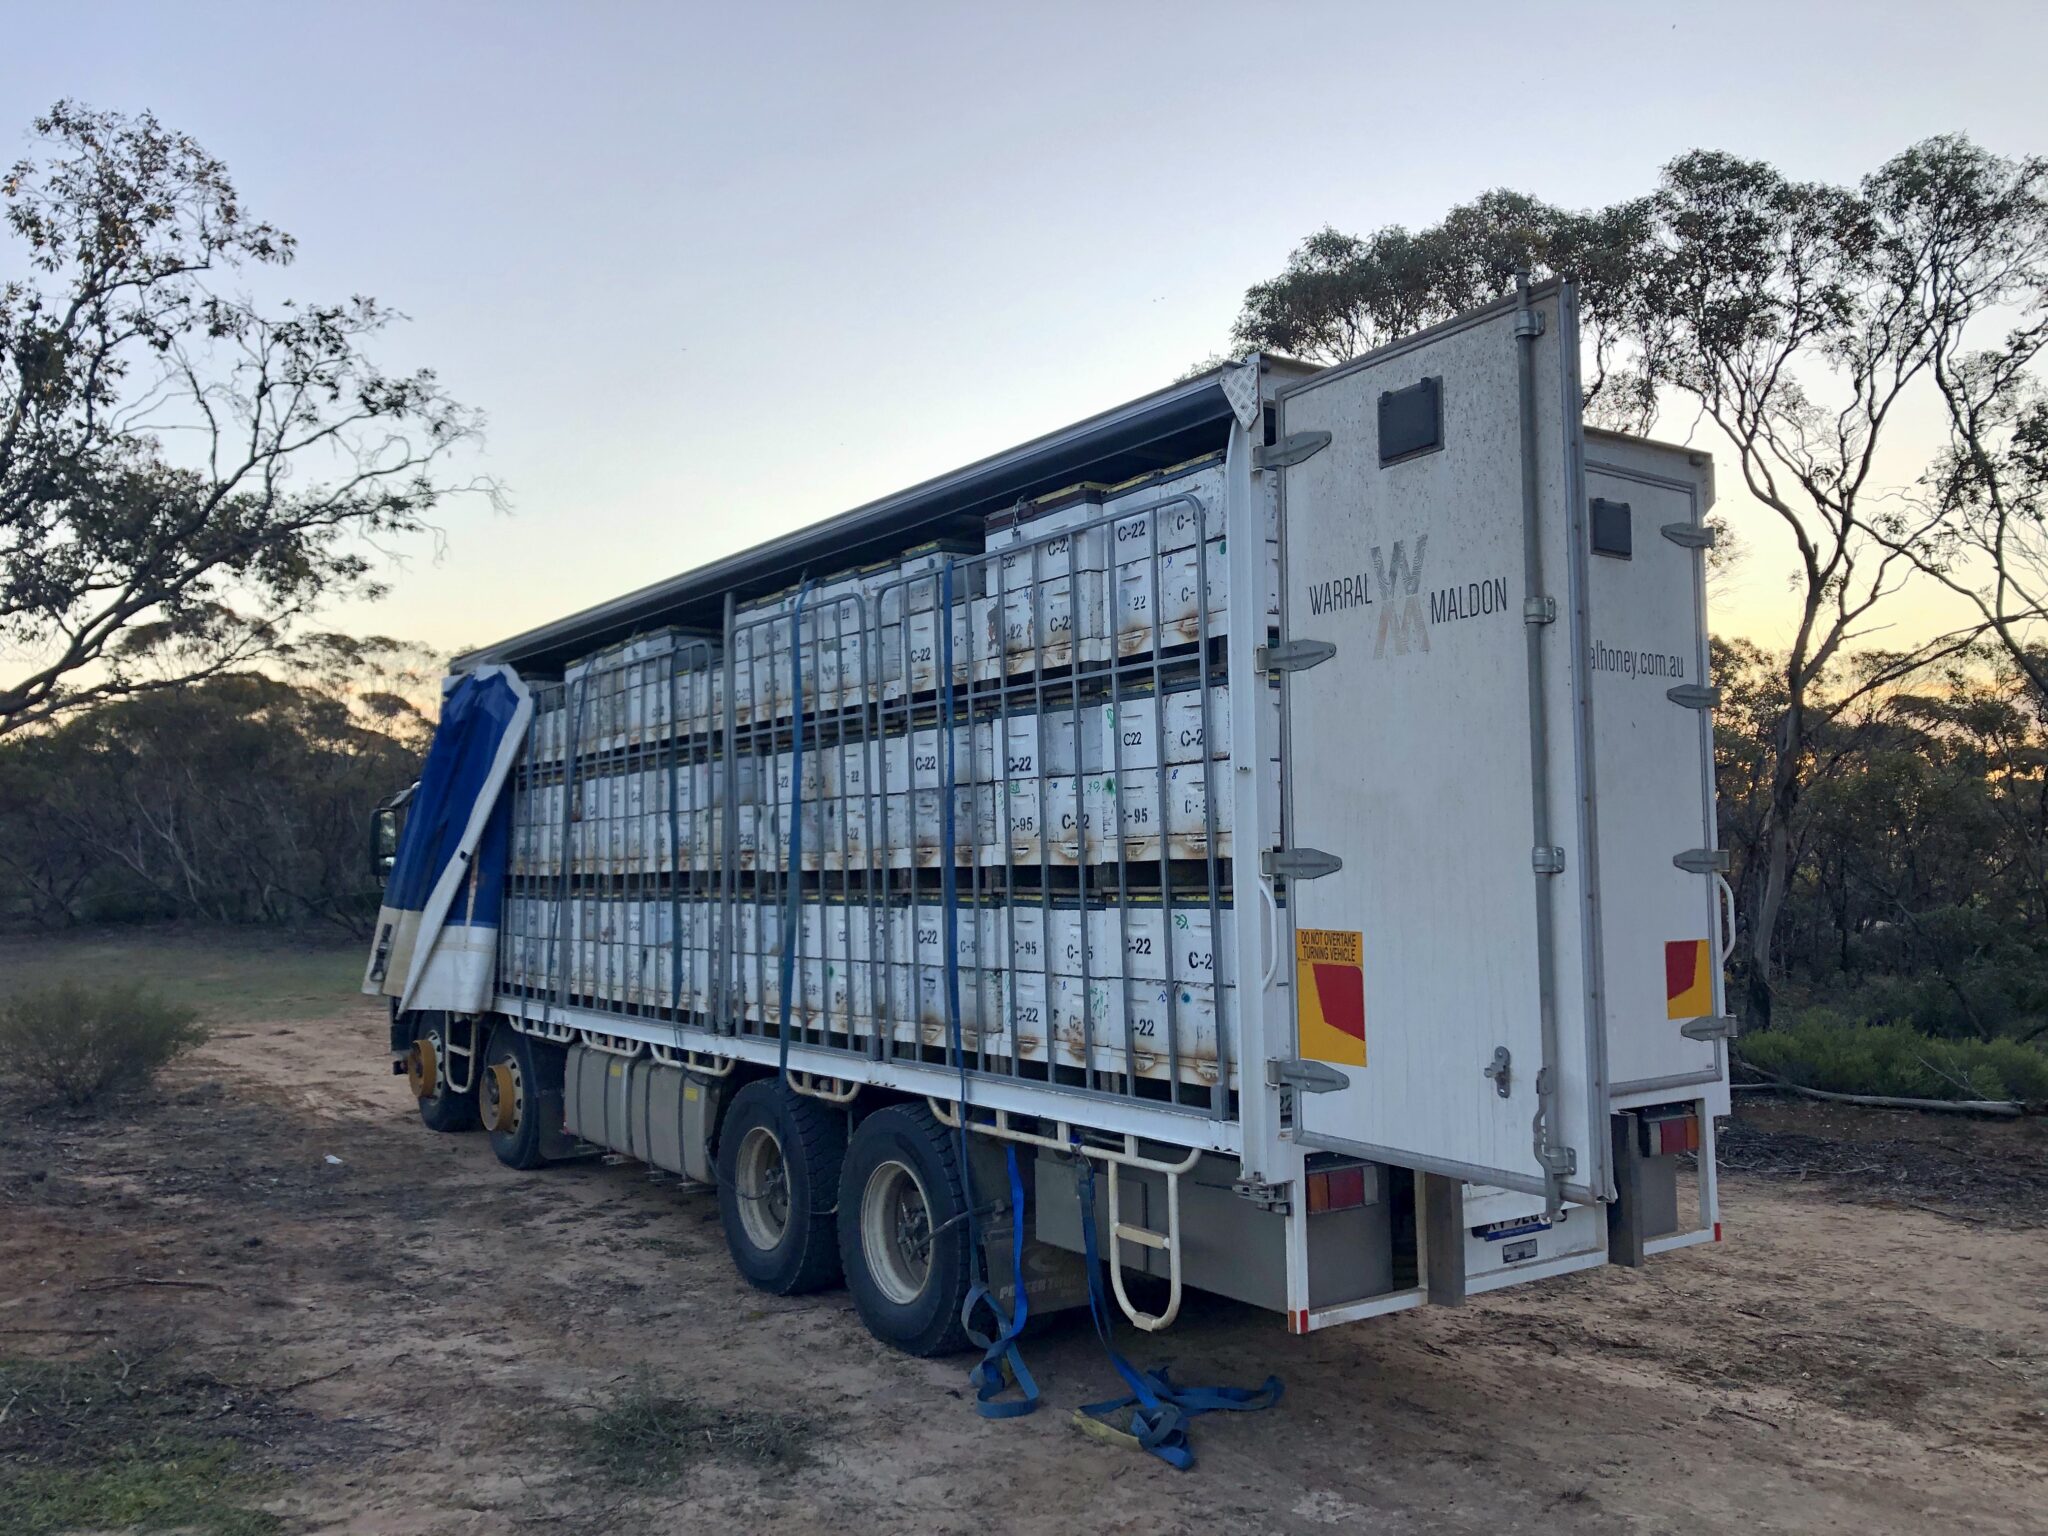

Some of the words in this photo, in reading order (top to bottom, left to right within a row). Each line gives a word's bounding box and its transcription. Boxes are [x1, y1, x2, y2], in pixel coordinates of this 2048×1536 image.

[1118, 520, 1146, 542] C-22
[1309, 573, 1373, 616] WARRAL
[1430, 576, 1507, 625] MALDON
[911, 647, 931, 664] C-22
[1123, 732, 1142, 747] C22
[1181, 729, 1204, 747] C-2
[915, 756, 936, 771] C-22
[1008, 756, 1032, 772] C-22
[1062, 814, 1090, 830] C-2
[918, 930, 938, 945] C-22
[1301, 931, 1310, 945] DO
[1310, 932, 1323, 946] NOT
[1324, 932, 1356, 948] OVERTAKE
[1188, 951, 1213, 970] C-2
[1303, 946, 1328, 961] TURNING
[1330, 947, 1356, 962] VEHICLE
[1132, 1019, 1155, 1037] -22
